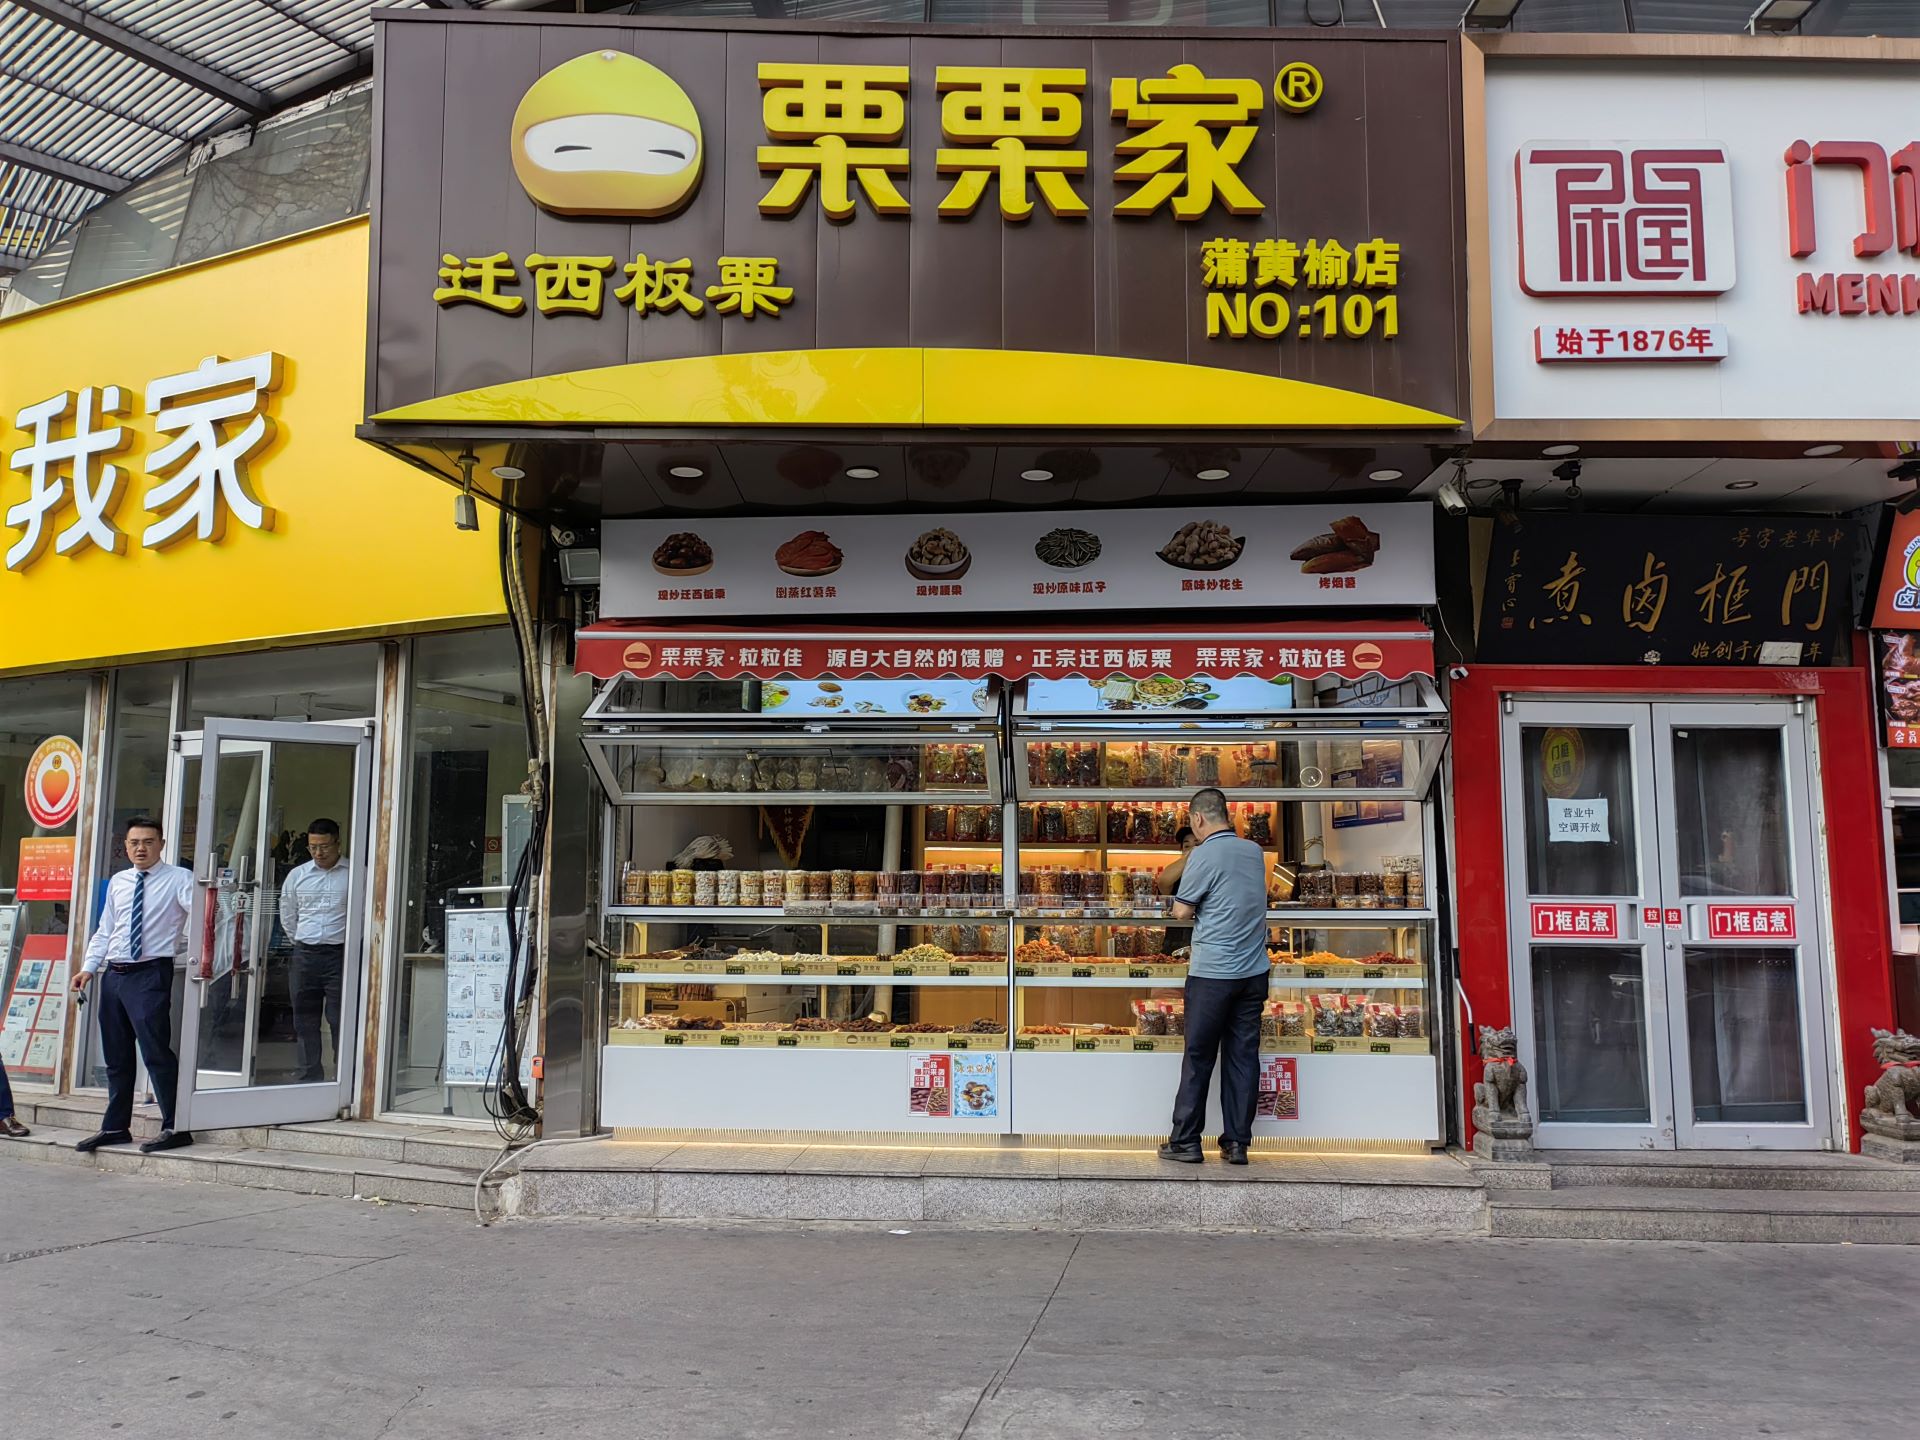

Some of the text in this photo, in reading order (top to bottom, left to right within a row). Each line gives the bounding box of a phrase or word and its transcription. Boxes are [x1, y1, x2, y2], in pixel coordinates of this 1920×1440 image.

[757, 62, 1266, 222] 栗栗家
[1784, 139, 1920, 258] 门
[1201, 237, 1400, 291] 蒲黄榆店
[433, 252, 795, 318] 迁西板栗
[1206, 292, 1399, 340] NO:101
[1556, 326, 1714, 355] 始于1876年
[1033, 581, 1107, 594] 现炒原味瓜子
[1181, 578, 1244, 591] 原味炒花生
[1319, 576, 1357, 589] 烤烟薯
[658, 588, 726, 601] 现炒迁西板栗
[775, 586, 837, 599] 倒蒸红薯条
[916, 584, 963, 596] 现烤腰果
[660, 647, 803, 668] 栗栗家·粒粒佳
[1196, 647, 1347, 669] 栗栗家·粒粒佳
[1563, 808, 1594, 819] 营业中
[1558, 822, 1601, 833] 空调开放
[1538, 910, 1610, 932] 门框卤煮
[1647, 910, 1658, 921] 拉
[1667, 910, 1679, 921] 拉
[1715, 910, 1788, 933] 门框卤煮
